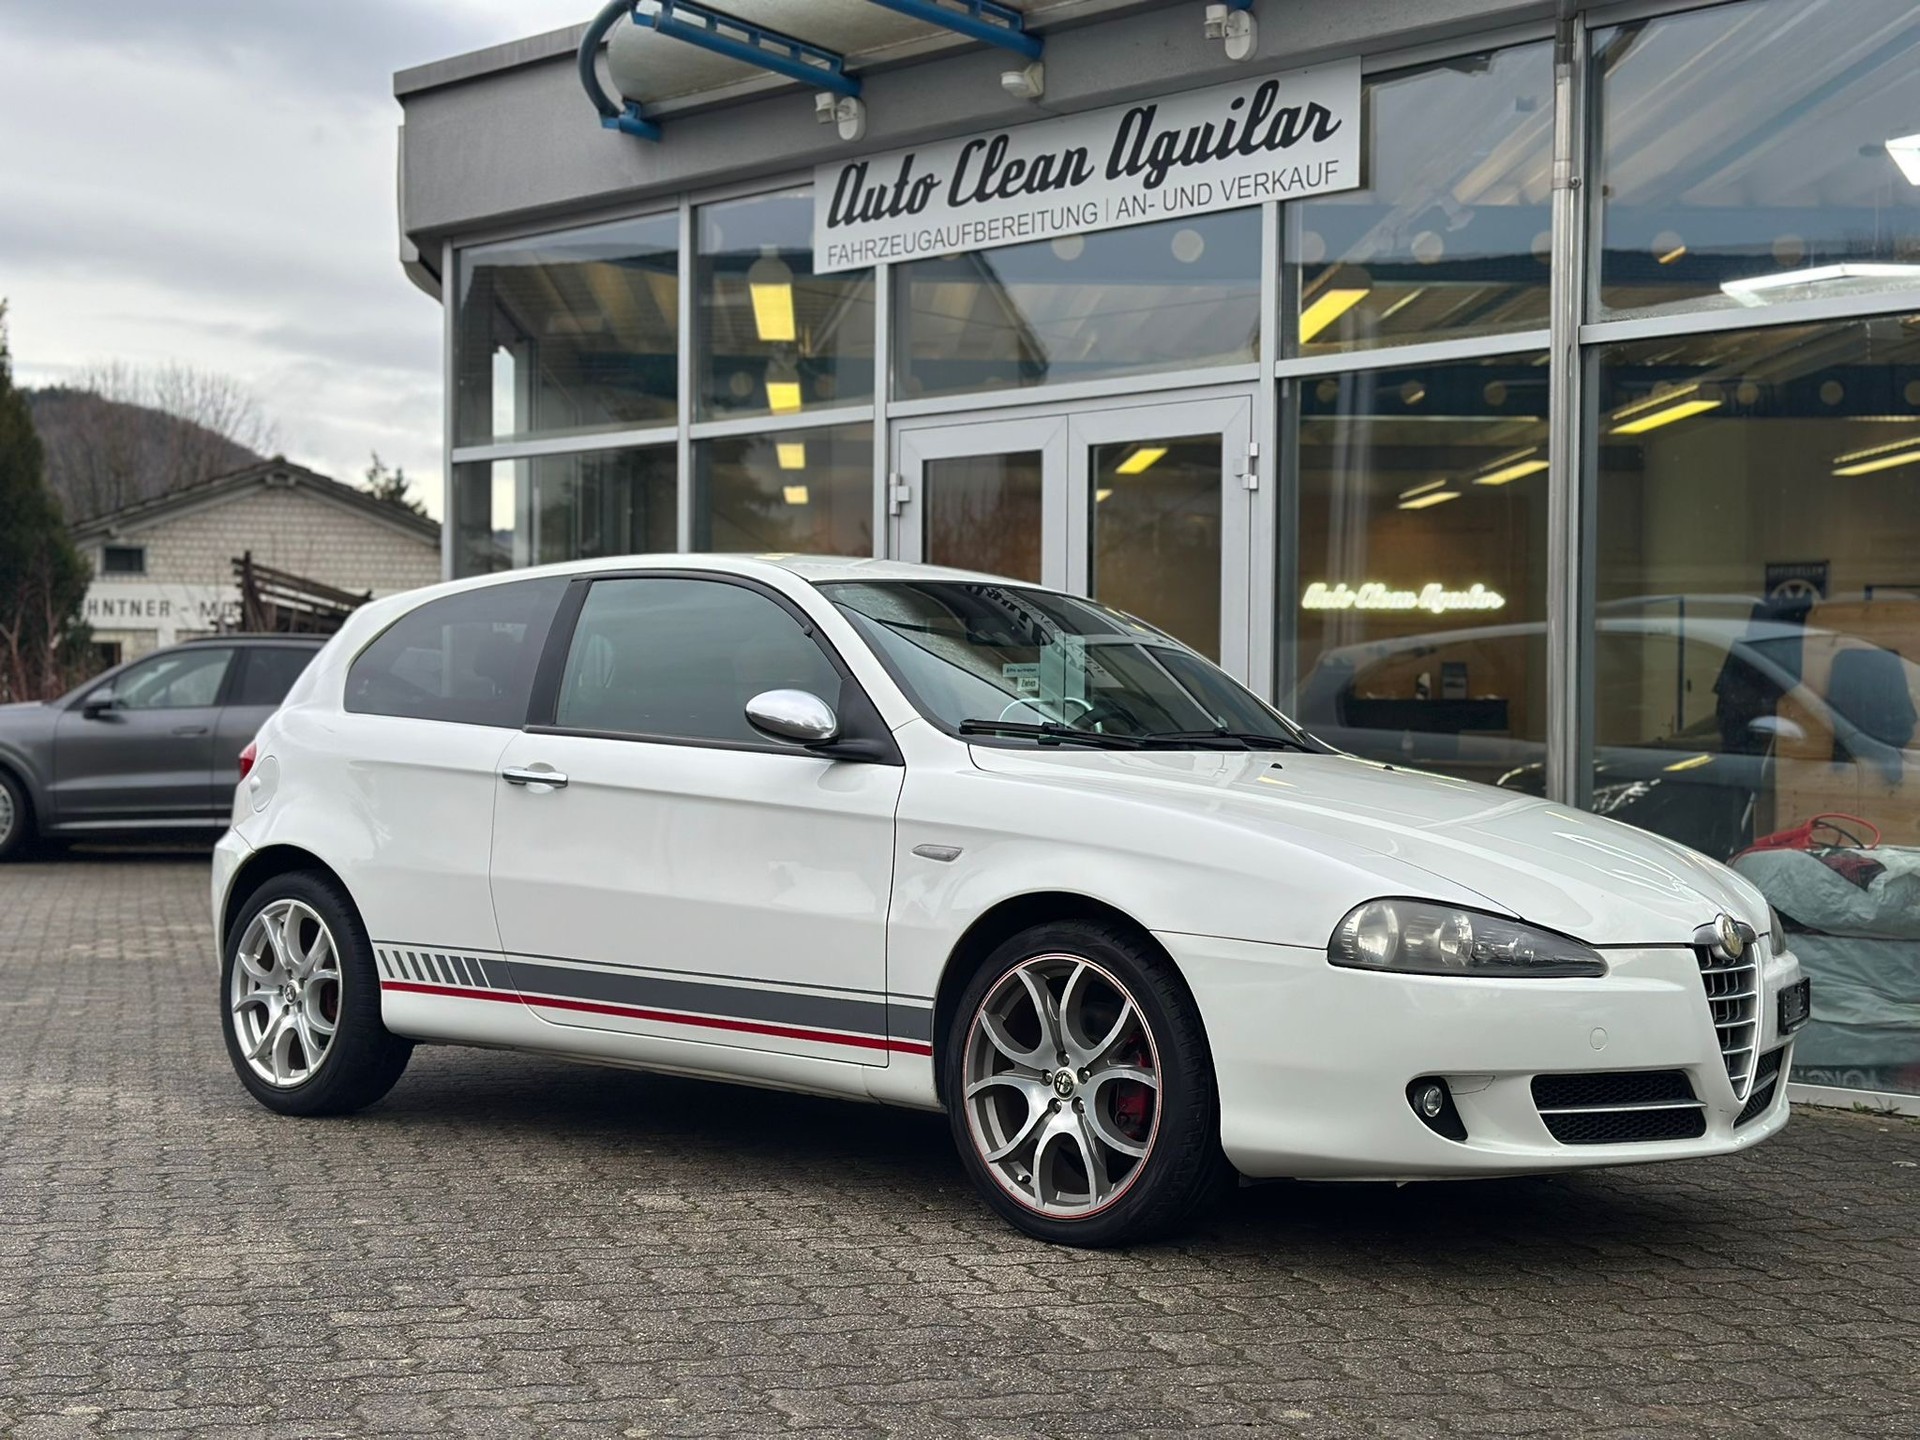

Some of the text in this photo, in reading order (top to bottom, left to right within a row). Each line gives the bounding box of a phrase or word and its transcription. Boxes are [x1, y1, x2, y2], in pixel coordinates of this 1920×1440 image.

[827, 79, 1342, 228] Auto Clean Aguilar
[828, 160, 1339, 267] FAHRZEUGAUFBEREITUNG AN- UND VERKAUF
